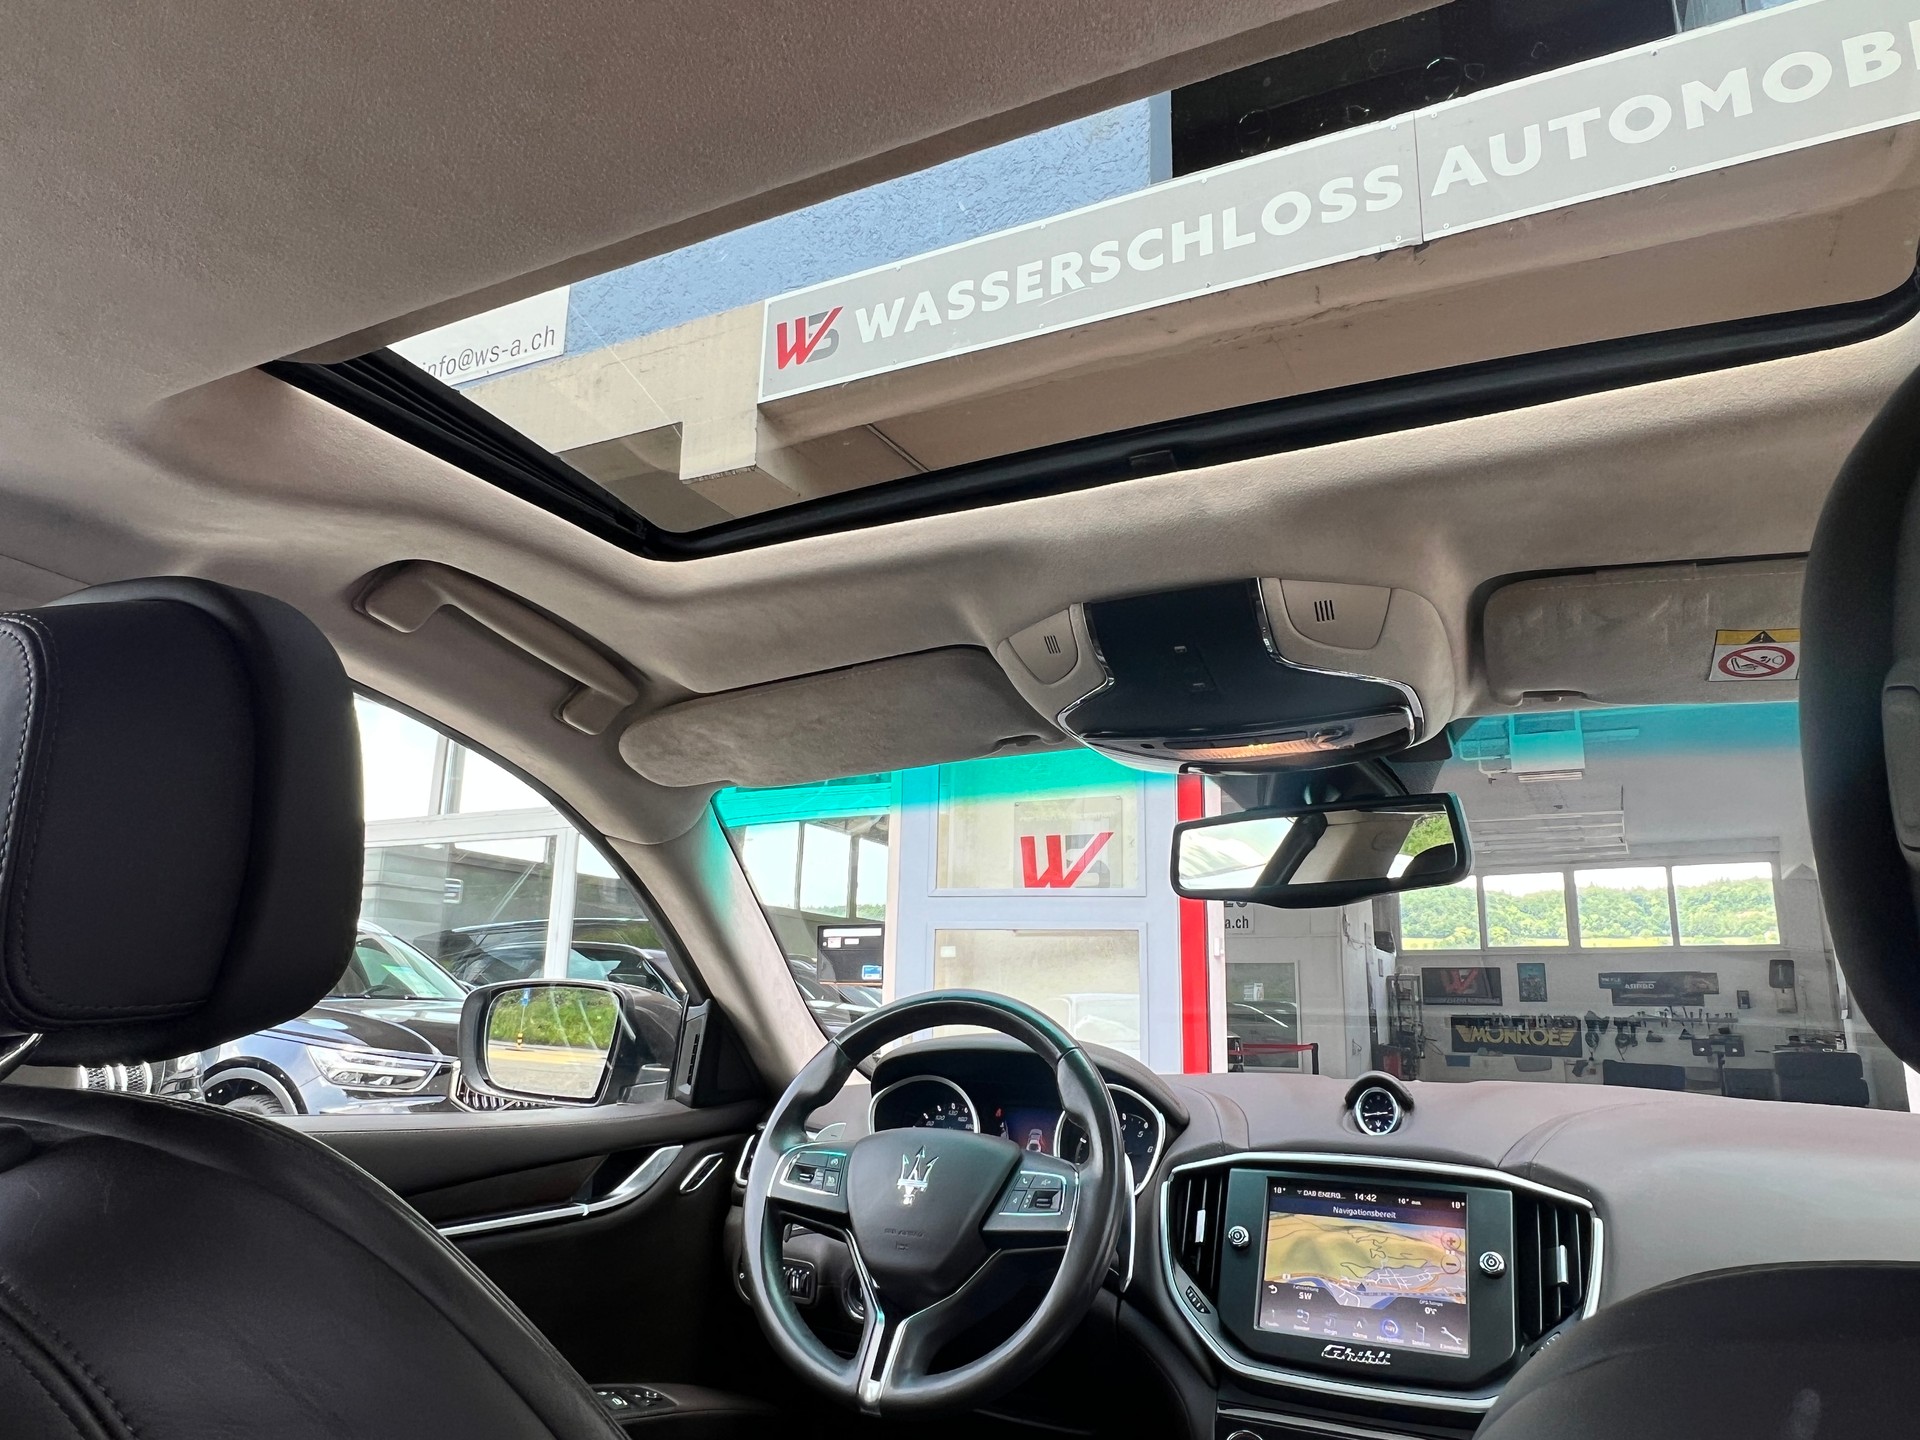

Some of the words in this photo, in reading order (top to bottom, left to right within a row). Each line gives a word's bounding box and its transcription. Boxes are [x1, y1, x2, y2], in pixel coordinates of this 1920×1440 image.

[855, 165, 1403, 343] WASSERSCHLOSS
[1469, 1025, 1562, 1046] MONROE
[1354, 1192, 1377, 1202] 14:42
[1332, 1205, 1397, 1219] Navigationsbereit
